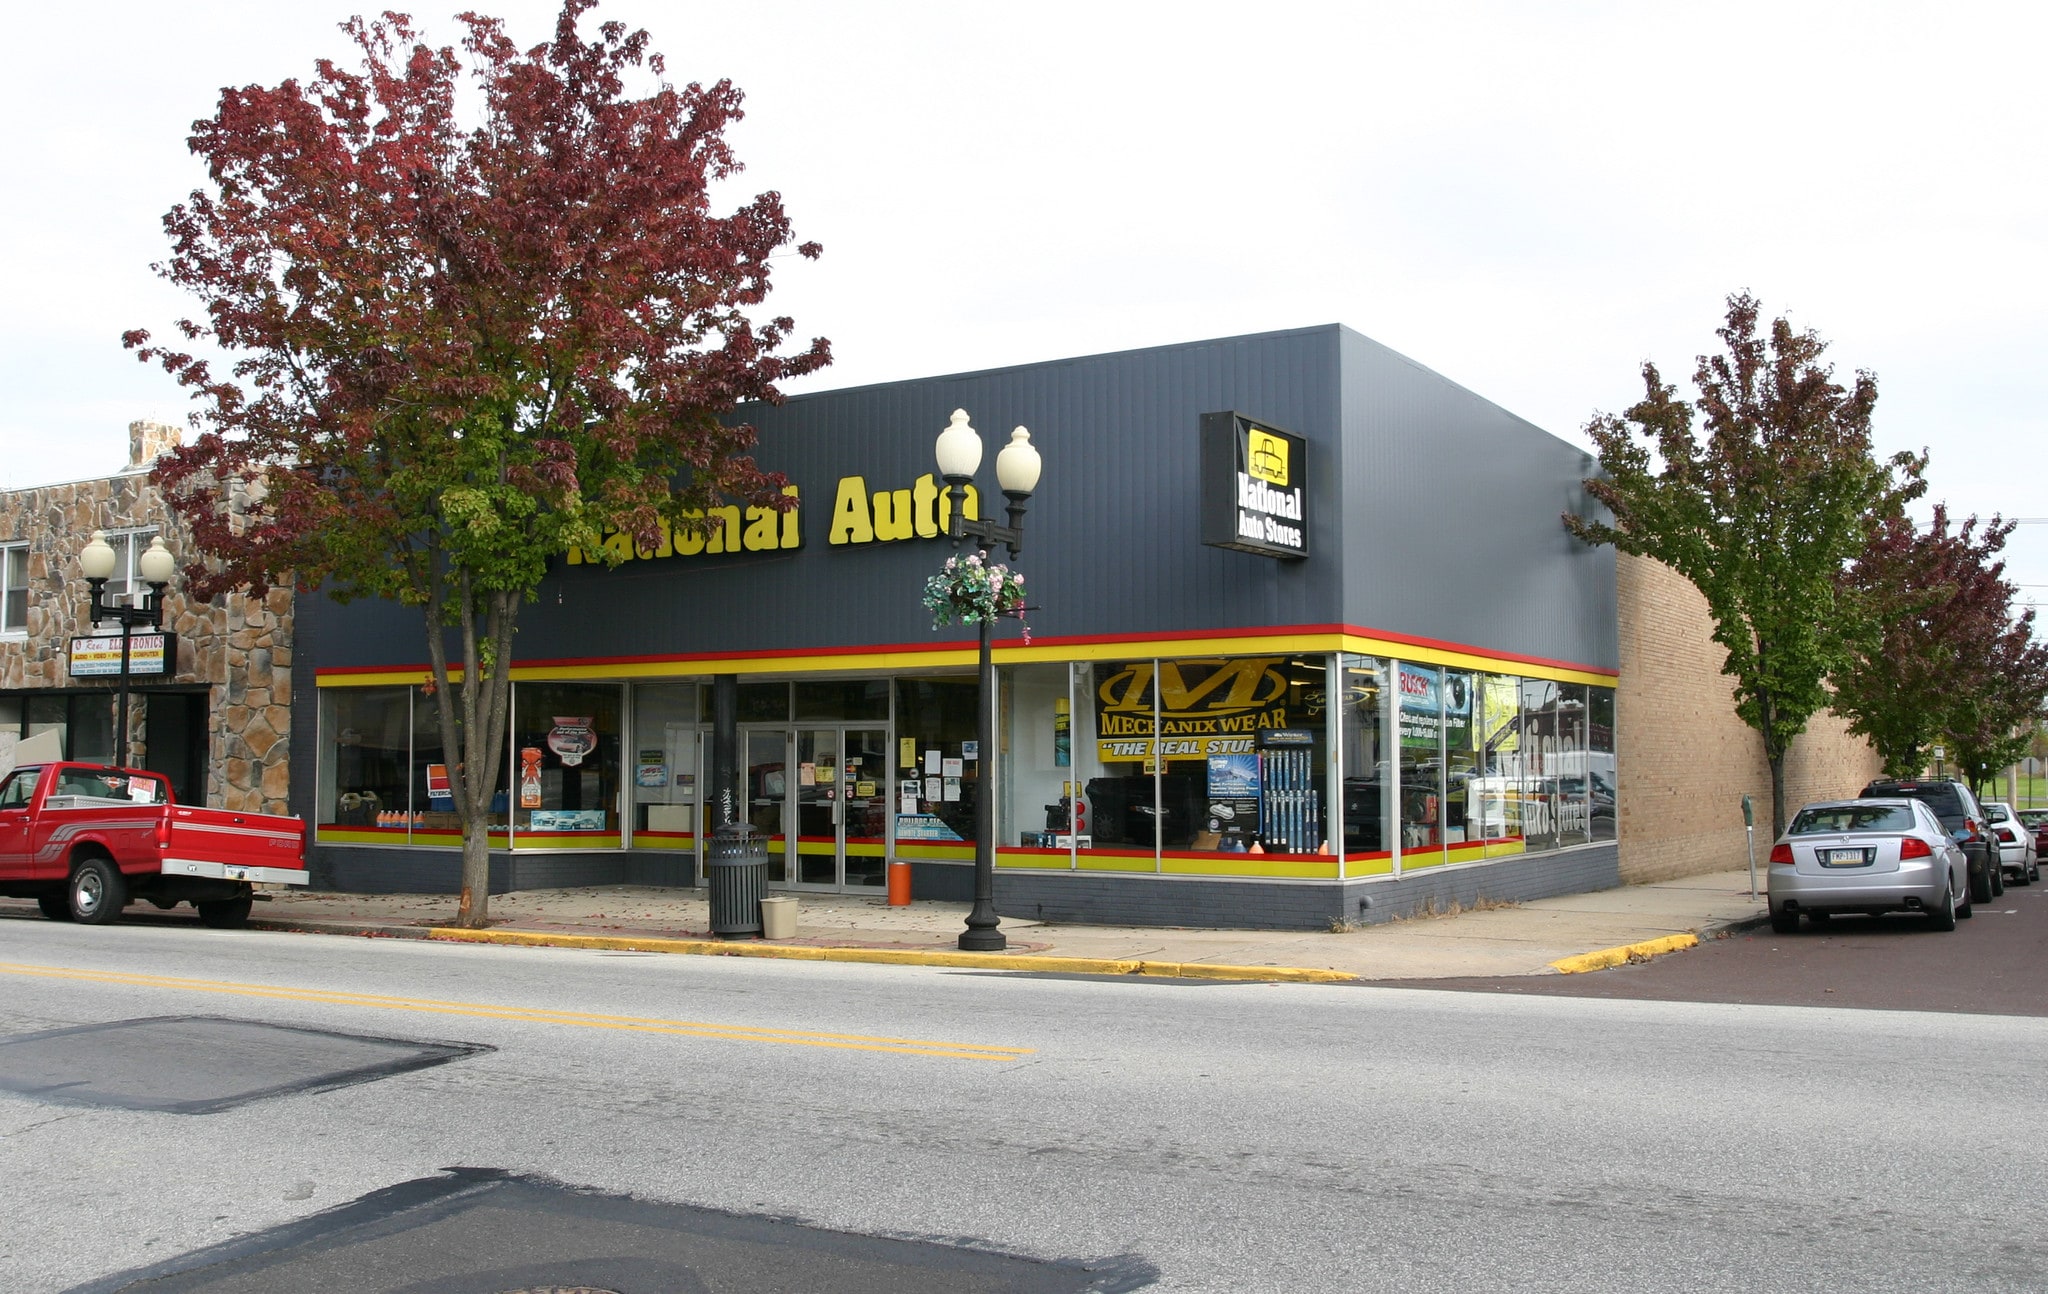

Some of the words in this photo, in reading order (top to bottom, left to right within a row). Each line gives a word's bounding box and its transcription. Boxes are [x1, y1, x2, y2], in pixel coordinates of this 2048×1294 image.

[828, 473, 979, 546] Auto
[1238, 471, 1302, 521] National
[1239, 509, 1264, 540] Auto
[1265, 516, 1302, 548] Stores
[1101, 712, 1218, 735] MECHANIX
[1219, 707, 1288, 732] WEAR
[268, 838, 300, 849] FORD
